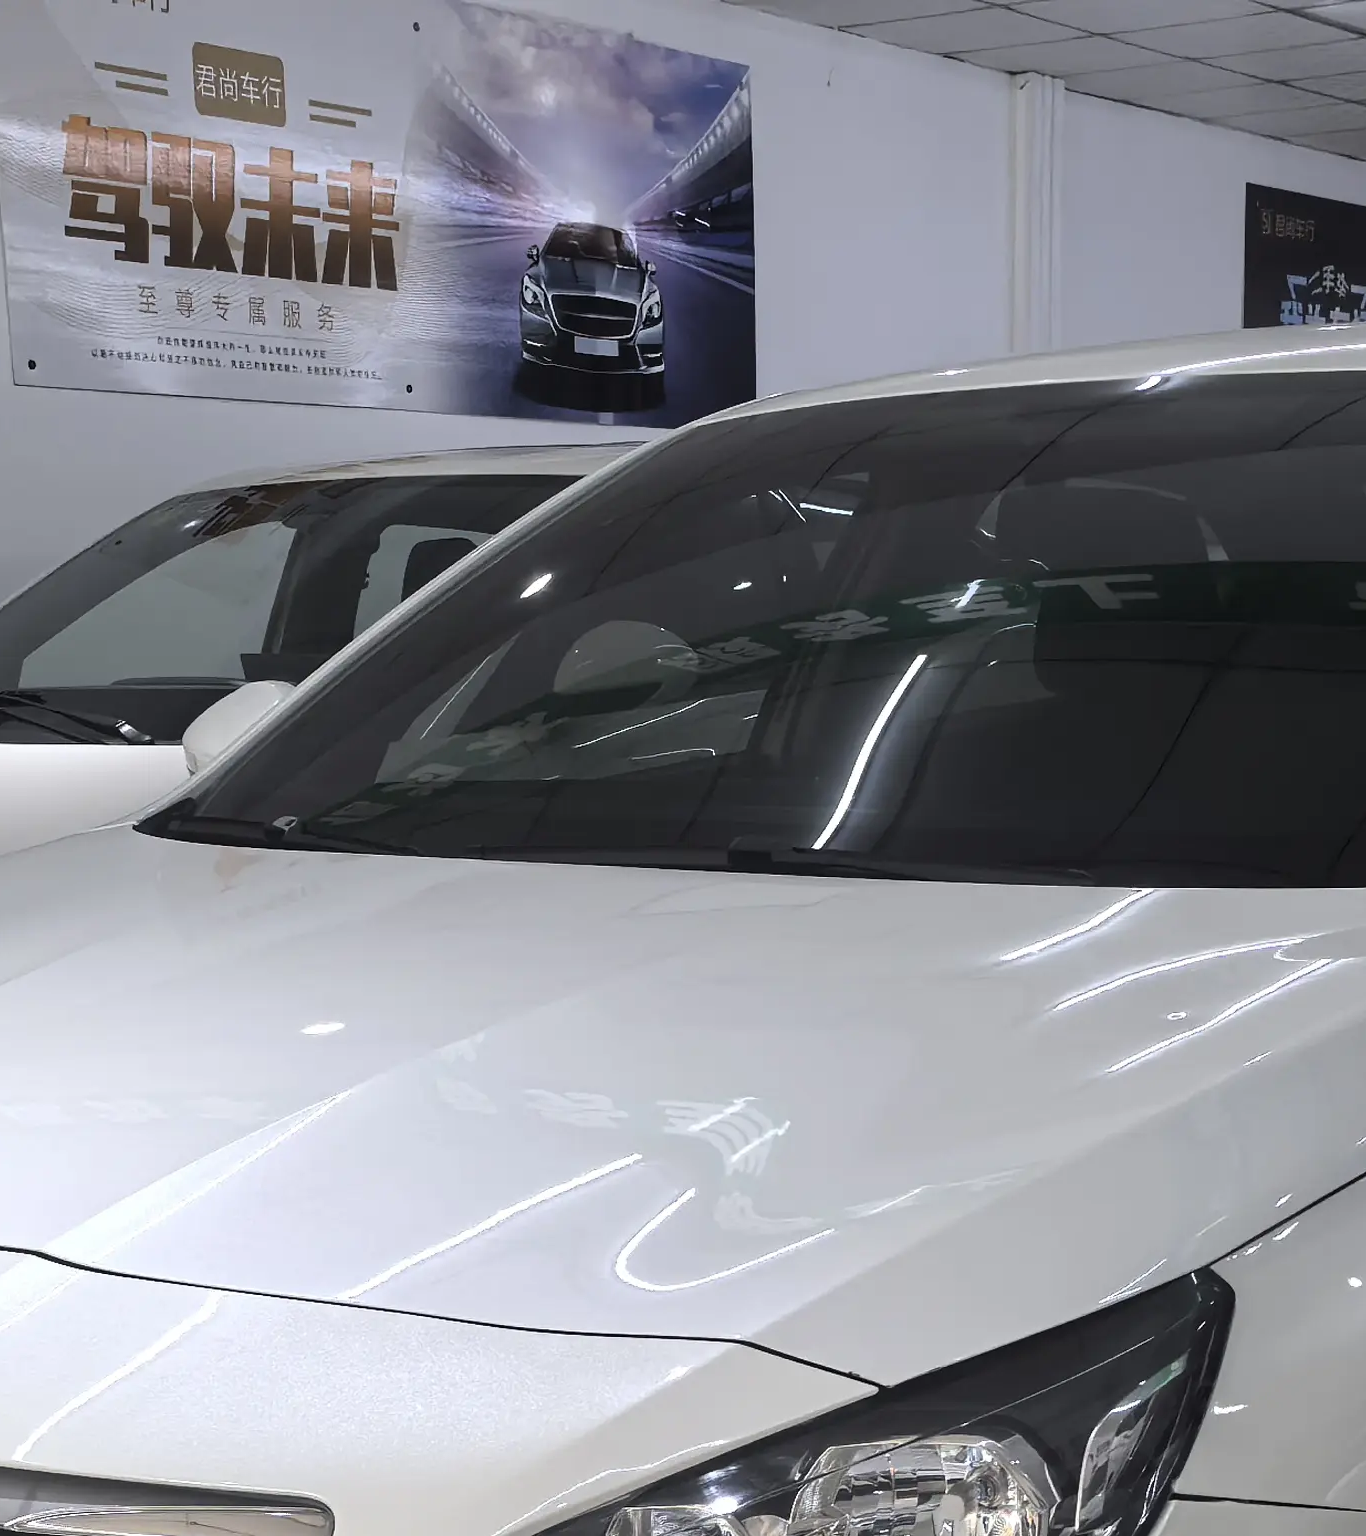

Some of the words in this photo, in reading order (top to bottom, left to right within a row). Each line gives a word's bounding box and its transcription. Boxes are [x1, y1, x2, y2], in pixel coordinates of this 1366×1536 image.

[195, 64, 282, 109] 君尚车行
[61, 114, 399, 291] 驾驭未来
[137, 284, 336, 333] 至尊专属服务
